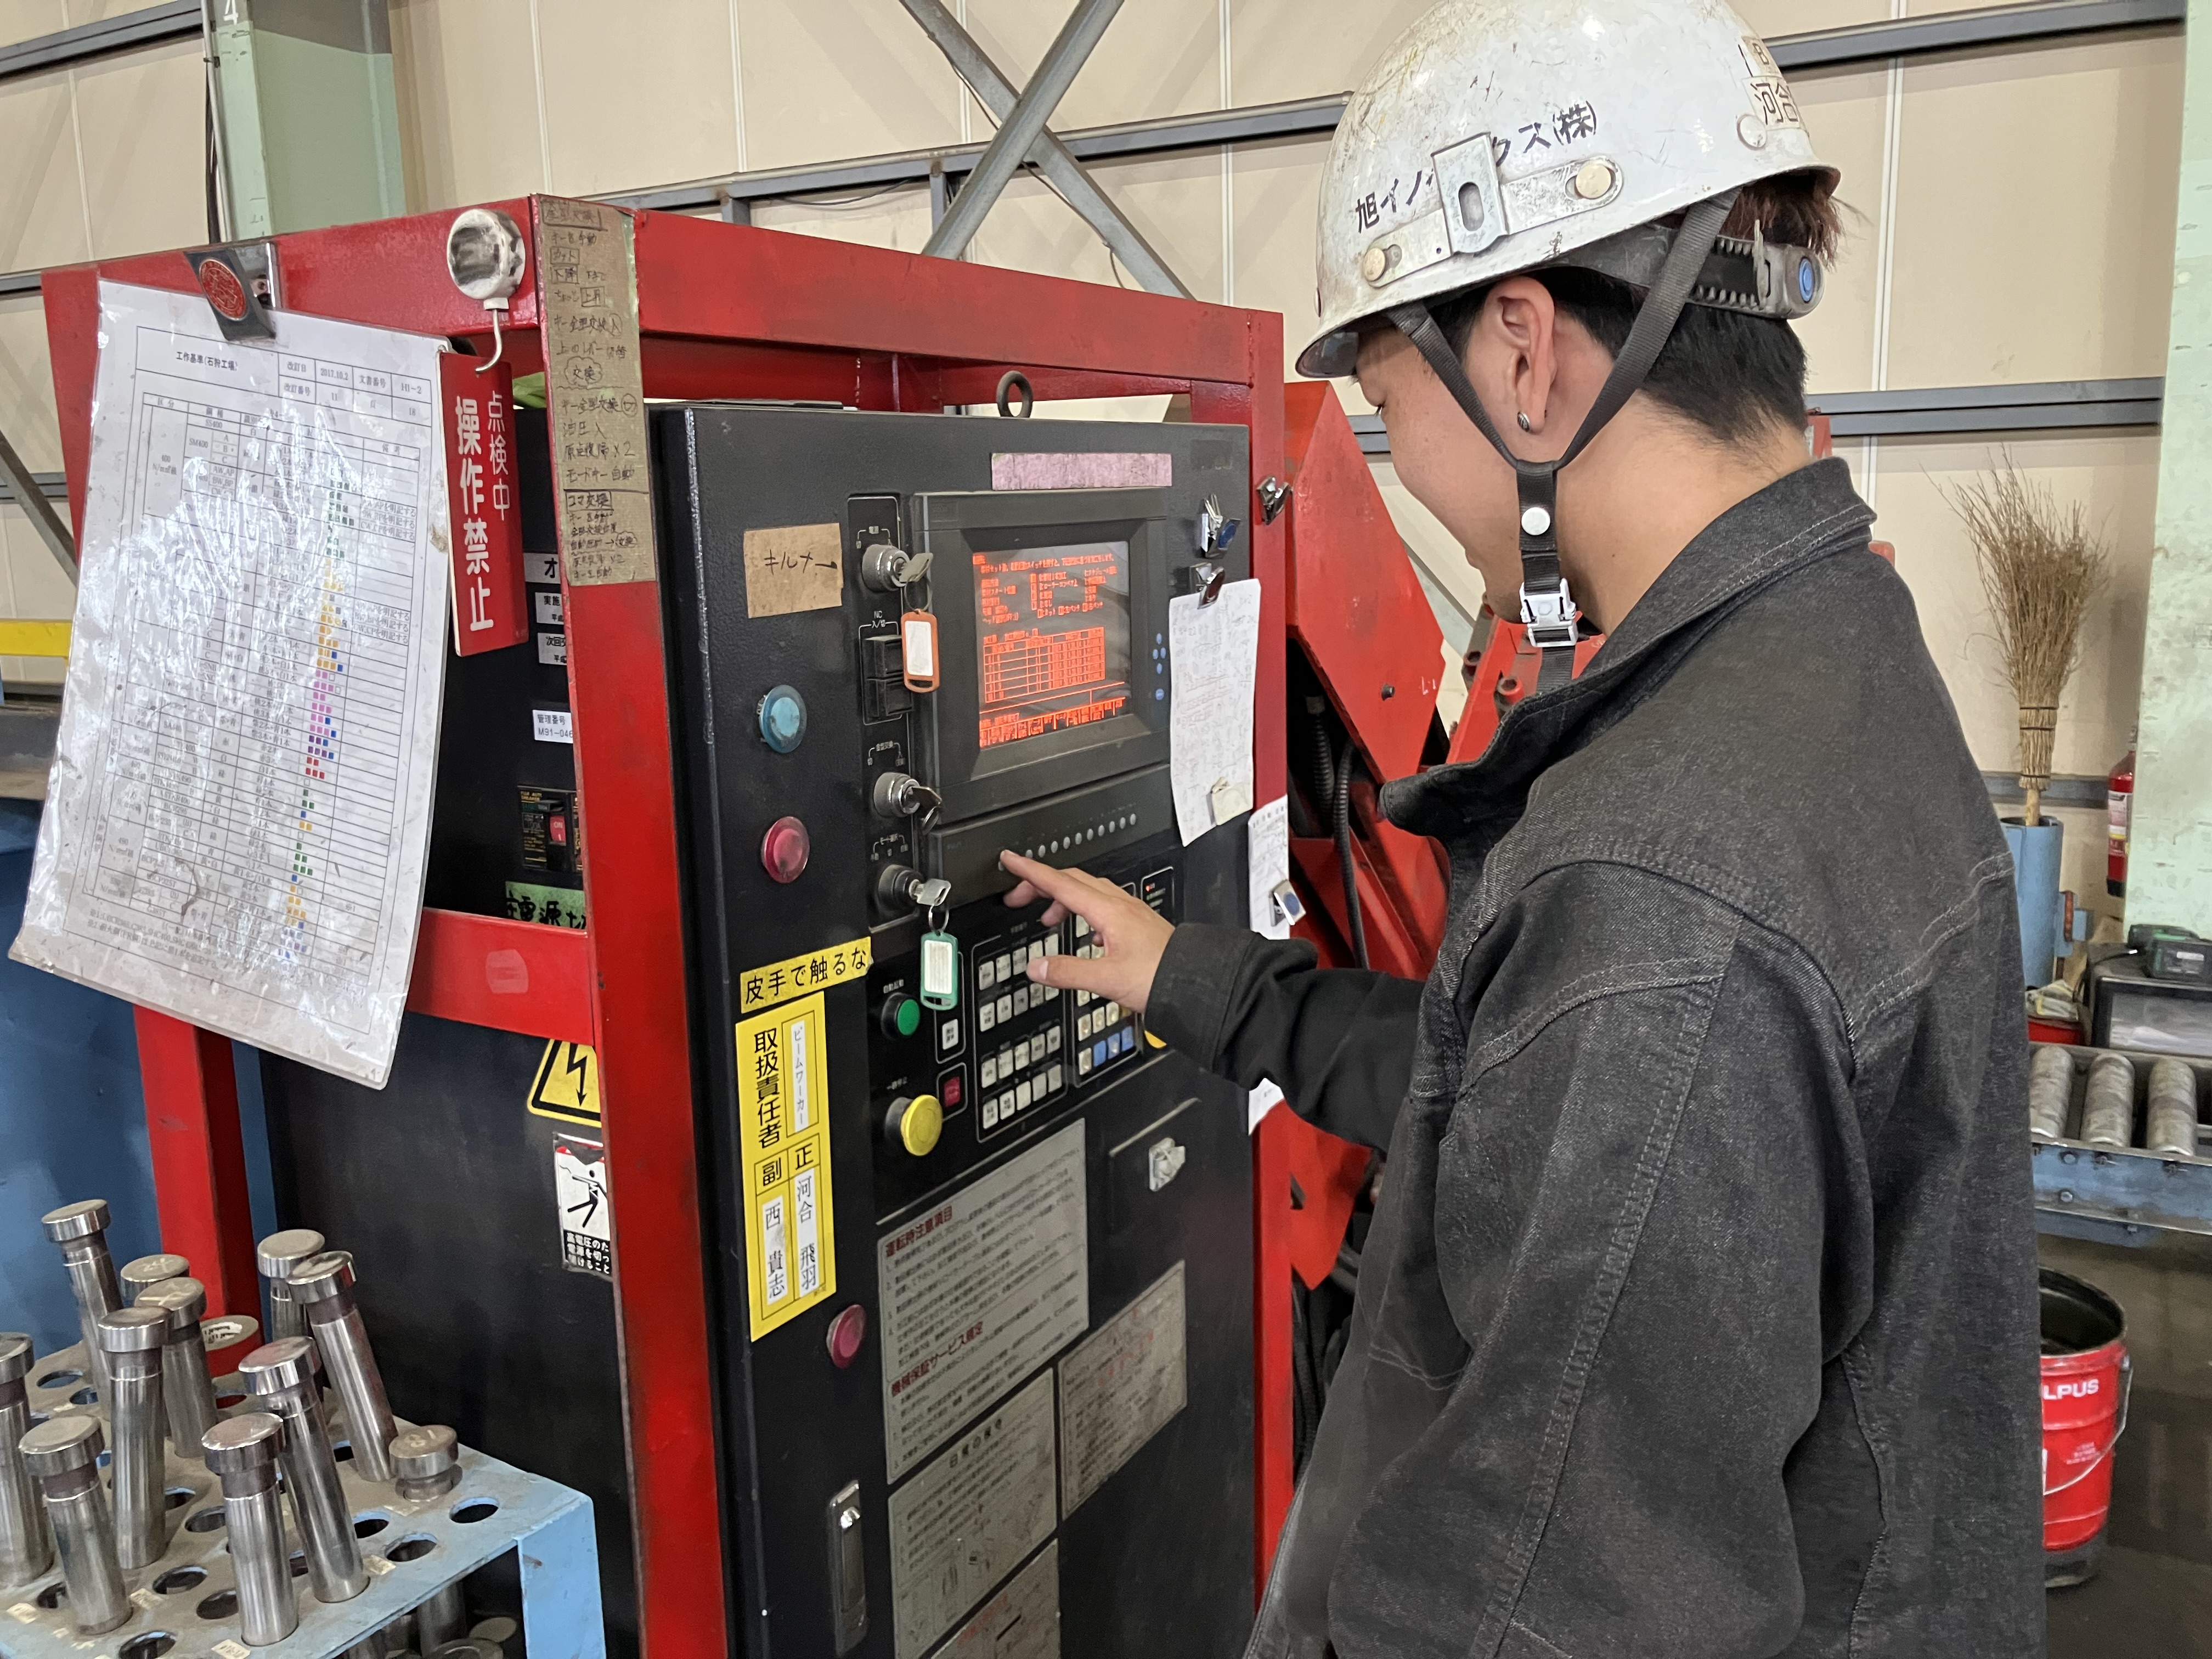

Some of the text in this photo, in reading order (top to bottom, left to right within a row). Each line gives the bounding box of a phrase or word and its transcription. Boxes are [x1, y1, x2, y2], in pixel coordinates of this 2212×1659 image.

[1750, 82, 1799, 125] 河合
[1355, 168, 1434, 234] 旭イノ
[320, 368, 349, 381] 2017.10.2
[487, 391, 511, 522] 点検中
[455, 395, 494, 633] 操作禁止
[874, 610, 883, 619] NC
[537, 714, 566, 726] 管理番号
[745, 946, 866, 1005] 皮手で触るな
[754, 1025, 805, 1149] 取扱責任者 ビームワーカー
[762, 1142, 814, 1187] 正 副
[797, 1175, 813, 1224] 河合
[765, 1202, 785, 1299] 西 貴志
[2041, 1378, 2100, 1401] LPUS
